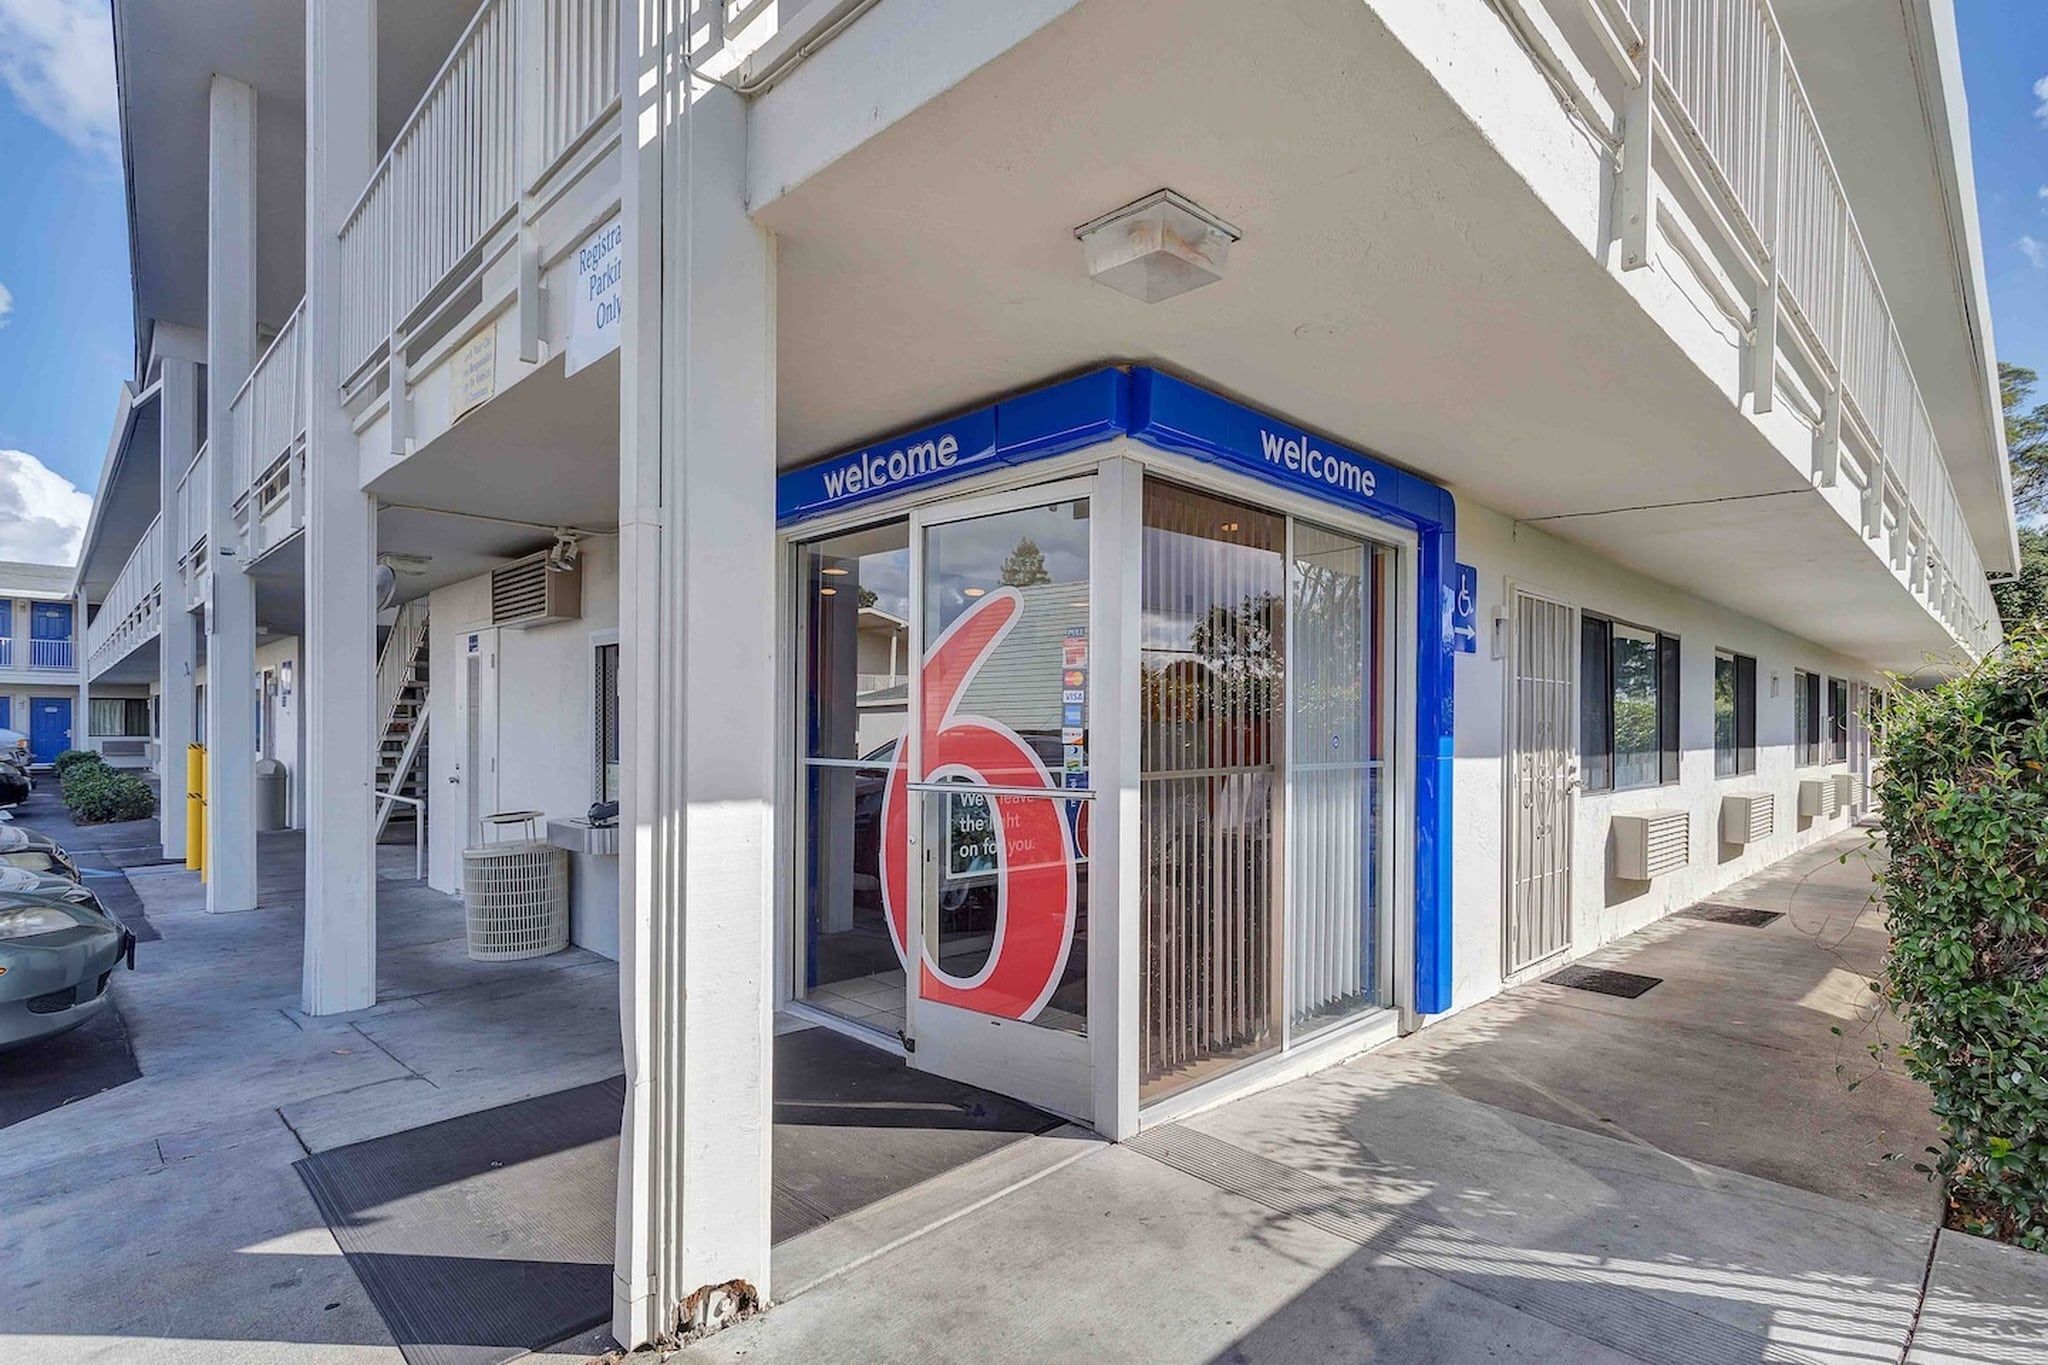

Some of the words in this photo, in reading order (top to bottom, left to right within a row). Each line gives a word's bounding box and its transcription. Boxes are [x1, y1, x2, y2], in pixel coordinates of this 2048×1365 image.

[579, 225, 621, 275] Registra
[590, 257, 621, 301] Parki
[597, 294, 622, 329] Only
[823, 434, 959, 498] welcome
[1261, 429, 1376, 497] welcome
[1065, 692, 1083, 701] VISA
[880, 585, 1077, 1023] 6
[960, 814, 984, 832] the
[960, 844, 978, 857] on
[983, 837, 998, 855] fo
[1008, 839, 1035, 857] you.
